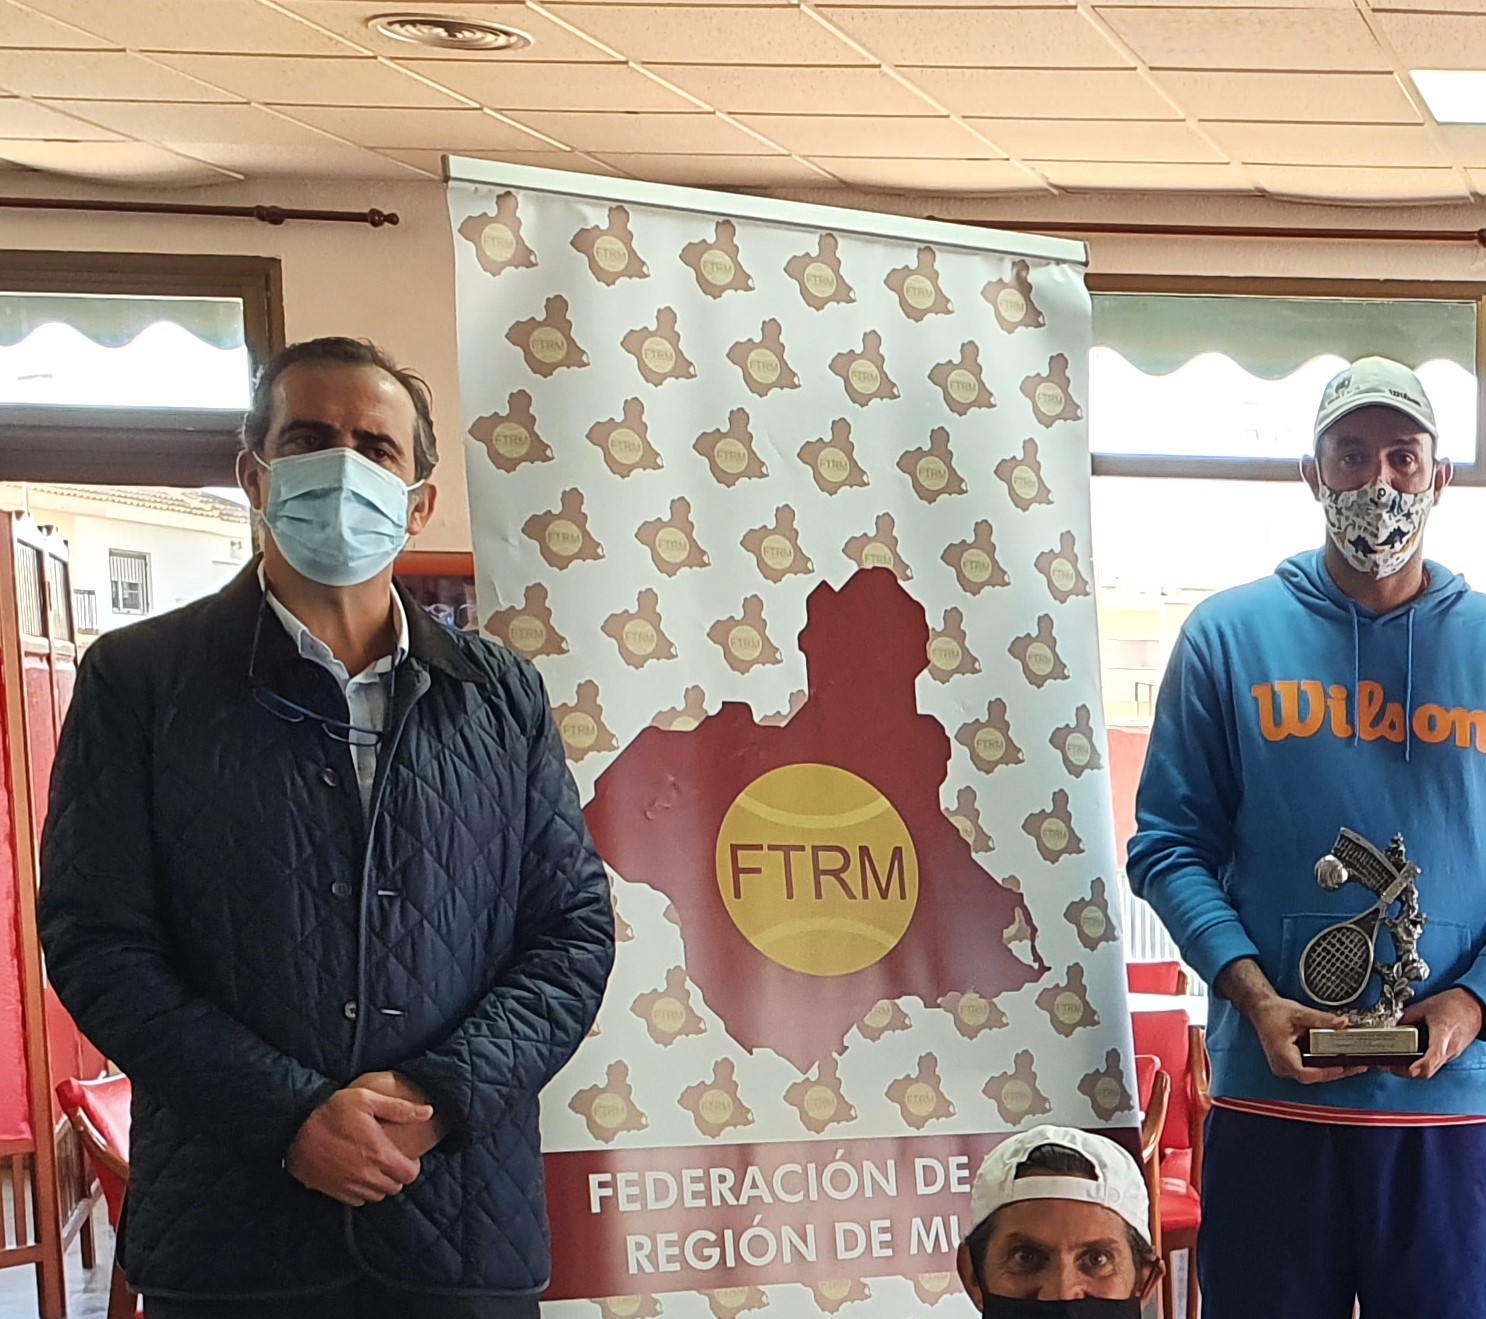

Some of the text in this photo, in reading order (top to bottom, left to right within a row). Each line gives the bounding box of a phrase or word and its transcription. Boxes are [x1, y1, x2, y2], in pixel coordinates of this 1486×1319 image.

[596, 247, 626, 258] FTRM
[703, 261, 732, 272] FTRM
[806, 274, 834, 285] FTRM
[905, 286, 933, 297] FTRM
[532, 339, 564, 350] FTRM
[644, 349, 673, 359] FTRM
[749, 360, 778, 370] FTRM
[851, 371, 878, 381] FTRM
[949, 381, 976, 390] FTRM
[1037, 393, 1062, 403] FTRM
[495, 434, 528, 444] FTRM
[716, 450, 746, 460] FTRM
[820, 459, 847, 469] FTRM
[918, 468, 946, 477] FTRM
[548, 532, 580, 543] FTRM
[658, 540, 687, 550] FTRM
[763, 547, 792, 557] FTRM
[963, 561, 990, 570] FTRM
[511, 628, 544, 638] FTRM
[625, 632, 655, 642] FTRM
[730, 638, 760, 647] FTRM
[932, 649, 959, 658] FTRM
[1028, 654, 1052, 663] FTRM
[563, 725, 595, 735] FTRM
[976, 739, 1003, 748] FTRM
[1042, 830, 1067, 838] FTRM
[730, 843, 907, 900] FTRM
[960, 1005, 987, 1013] FTRM
[1056, 1003, 1081, 1012] FTRM
[907, 1094, 934, 1103] FTRM
[701, 1102, 731, 1111] FTRM
[588, 1149, 971, 1213] FEDERACIÓN DE
[626, 1215, 817, 1274] REGIÓN
[834, 1219, 893, 1261] DE
